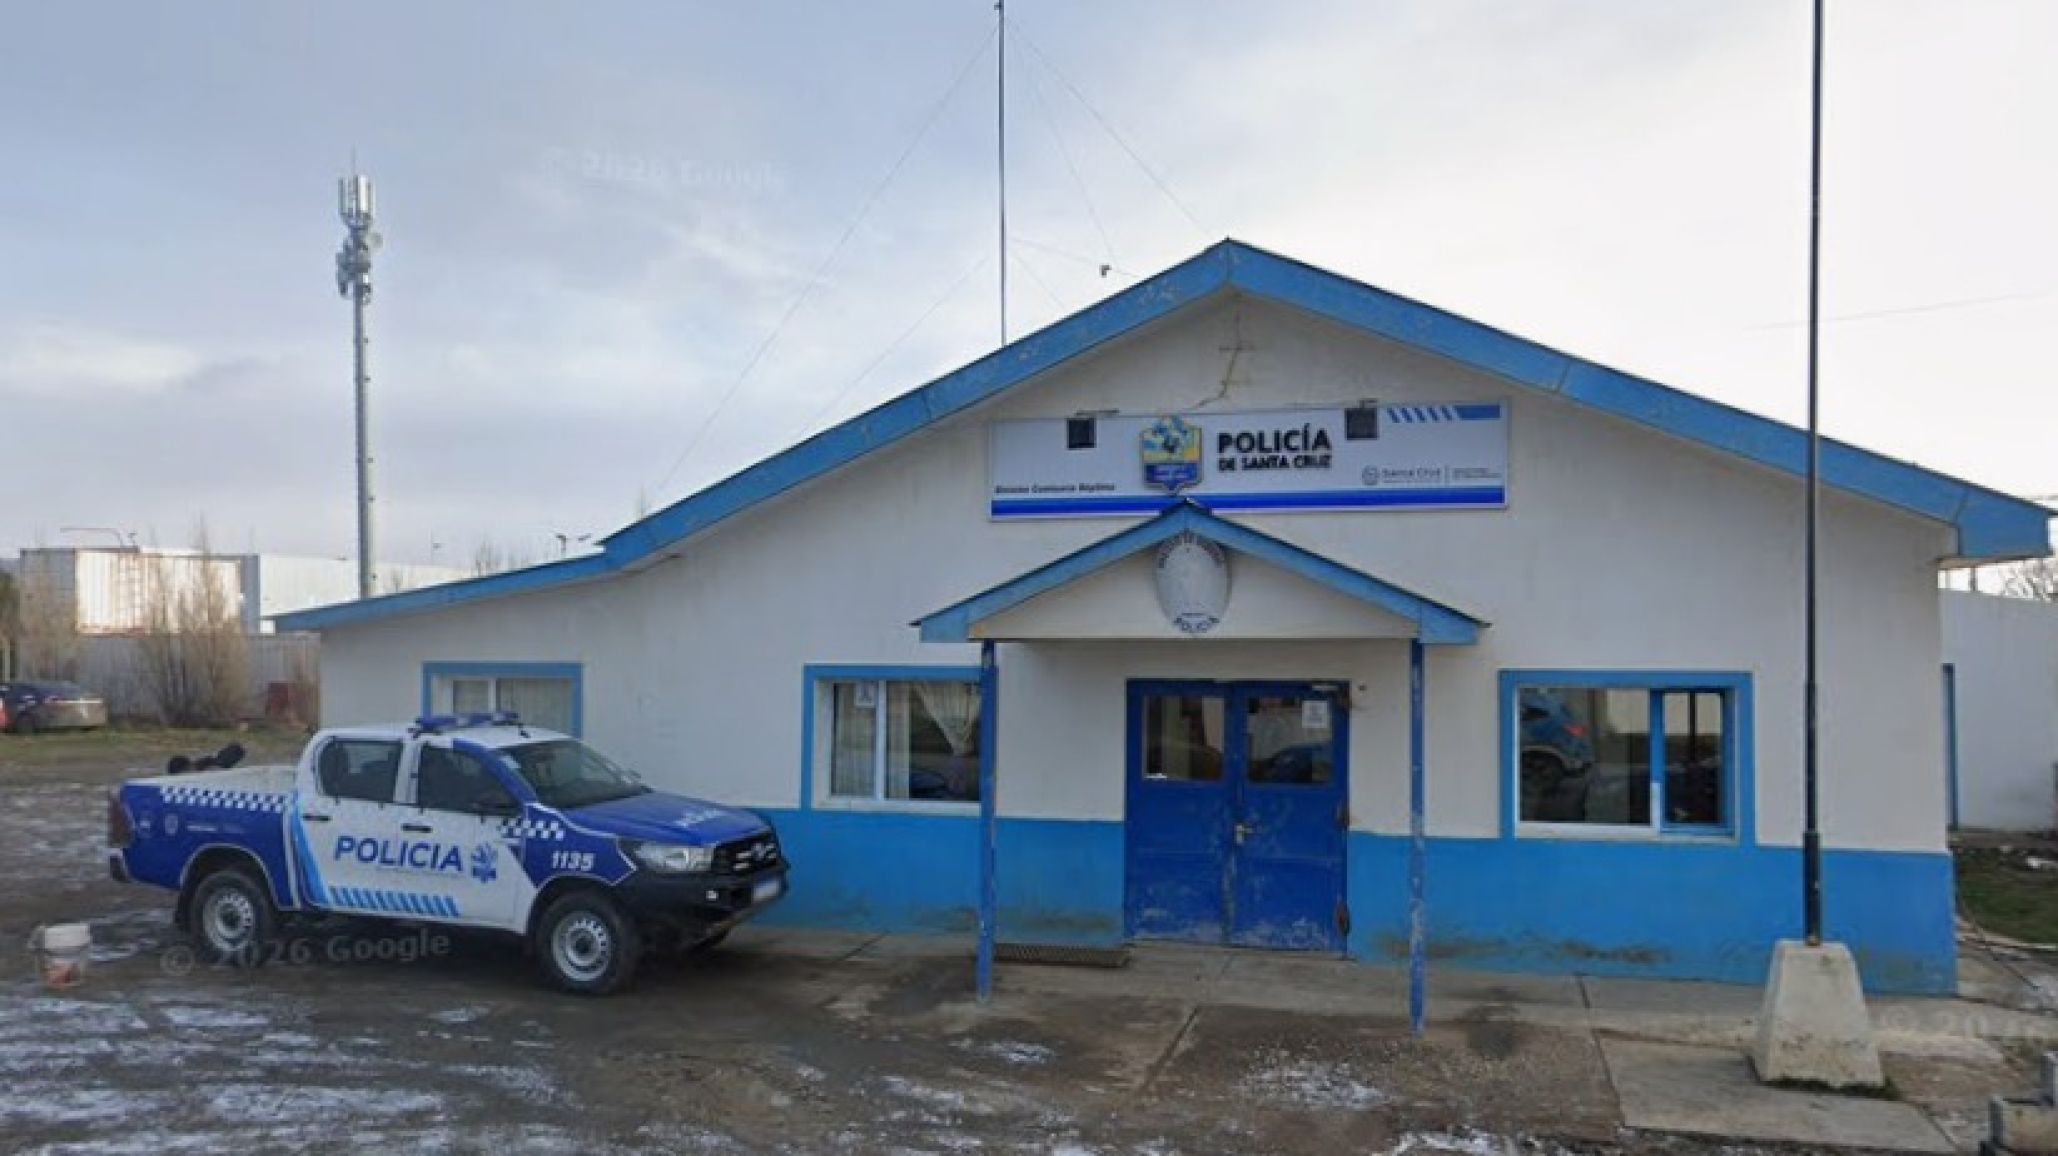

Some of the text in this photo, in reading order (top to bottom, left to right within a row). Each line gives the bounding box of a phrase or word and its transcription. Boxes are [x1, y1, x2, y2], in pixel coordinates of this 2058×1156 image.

[1218, 422, 1332, 453] POLICÍA
[1218, 454, 1332, 471] DE SANTA CRUZ
[334, 834, 463, 872] POLICIA
